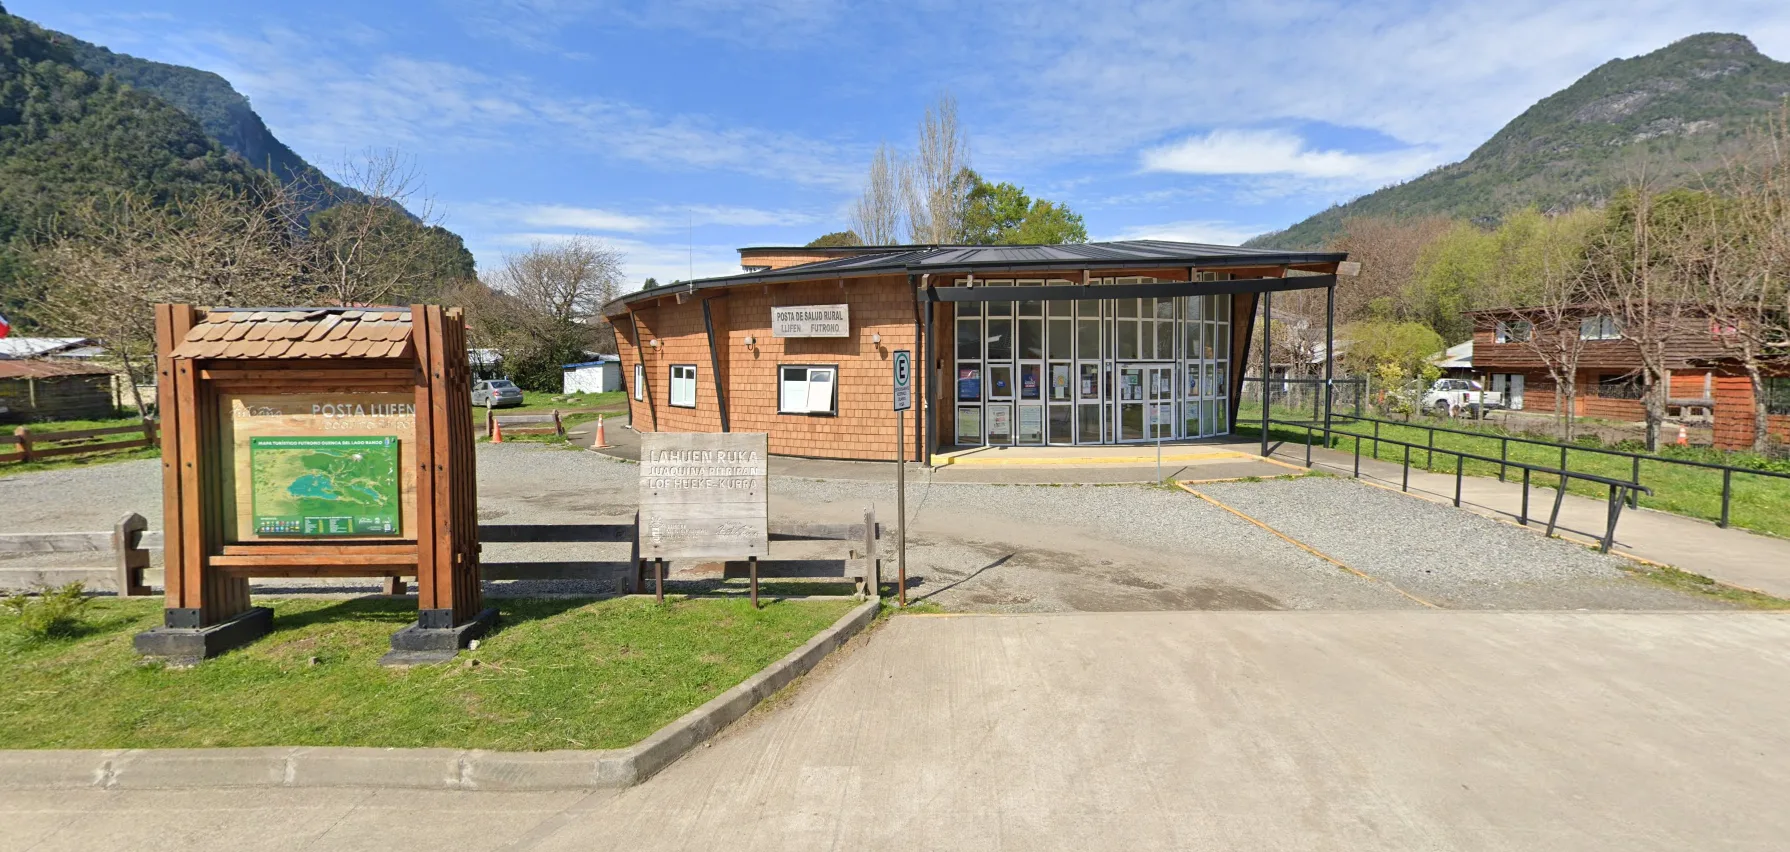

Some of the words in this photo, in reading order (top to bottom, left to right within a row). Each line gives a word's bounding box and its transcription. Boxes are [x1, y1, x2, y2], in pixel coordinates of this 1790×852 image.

[776, 312, 795, 322] POSTA
[795, 311, 804, 321] DE
[804, 311, 823, 321] SALUD
[823, 310, 844, 321] RURAL
[780, 324, 801, 333] LLIFEN
[810, 323, 840, 333] FUTRONO
[899, 360, 905, 379] E
[312, 404, 364, 418] POSTA
[371, 404, 416, 418] LLIFEN
[650, 449, 713, 464] LAHUEN
[717, 450, 758, 464] RUKA
[648, 479, 671, 489] LOF
